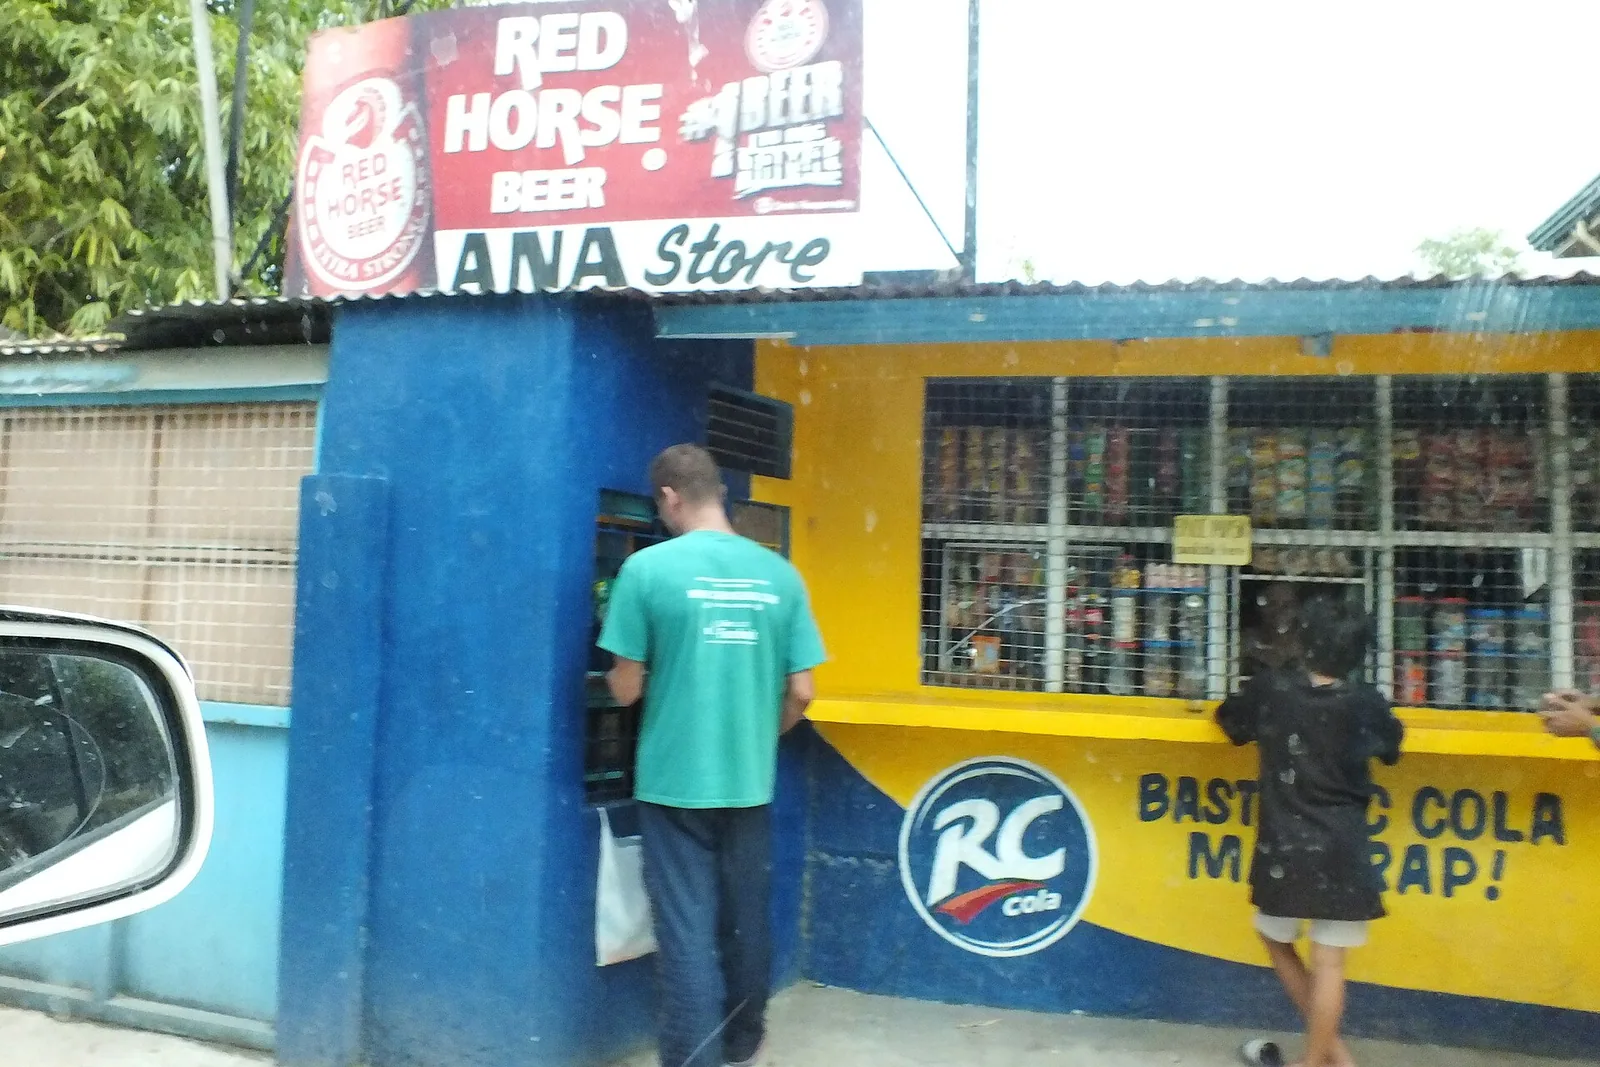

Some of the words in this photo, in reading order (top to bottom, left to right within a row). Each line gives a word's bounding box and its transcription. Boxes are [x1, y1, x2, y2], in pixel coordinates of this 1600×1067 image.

[494, 11, 628, 91] RED
[443, 83, 663, 166] HORSE
[327, 176, 404, 220] HORSE
[342, 152, 388, 189] RED
[490, 166, 607, 214] BEER
[347, 214, 388, 240] BEER
[452, 226, 630, 293] ANA
[644, 222, 831, 286] Store
[1139, 772, 1262, 827] BAST
[1412, 785, 1568, 846] COLA
[926, 794, 1067, 909] RC
[1001, 888, 1063, 918] cola
